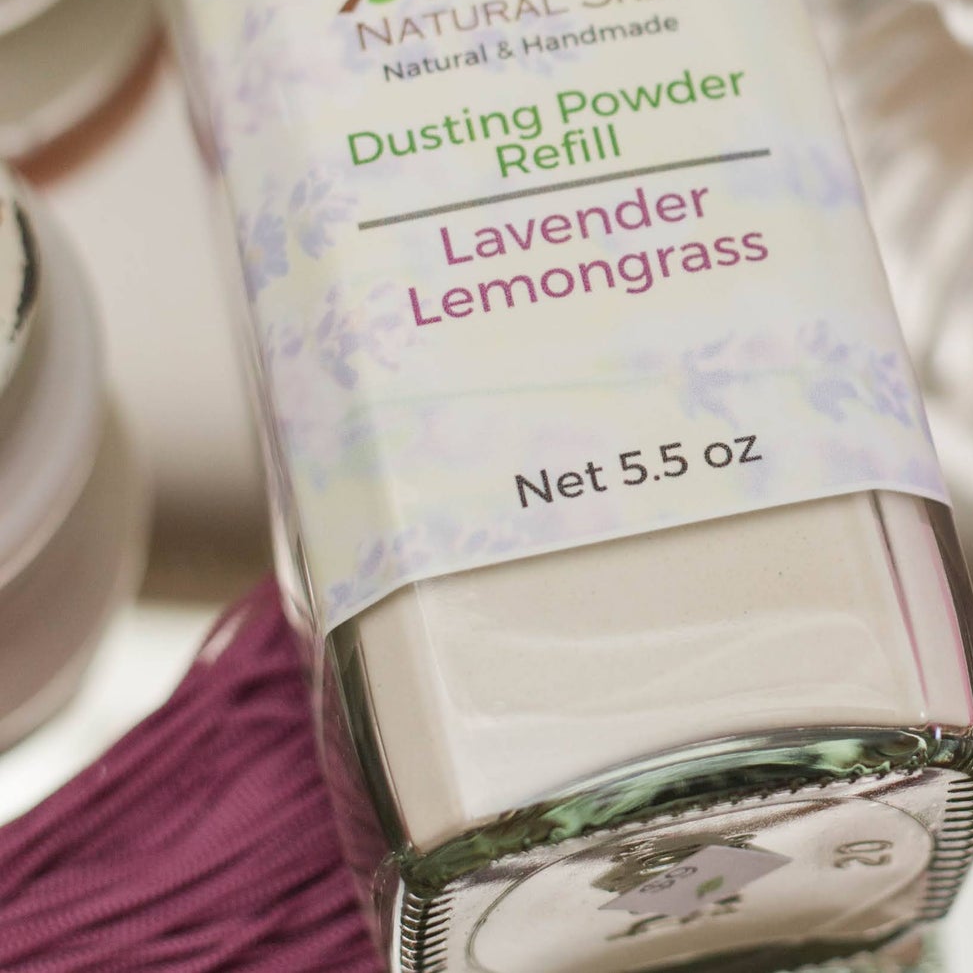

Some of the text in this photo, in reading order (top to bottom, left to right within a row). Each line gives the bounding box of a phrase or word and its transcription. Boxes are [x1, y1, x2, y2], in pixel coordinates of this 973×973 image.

[383, 14, 680, 83] Natural & Handmade
[347, 69, 746, 167] Dusting Powder
[495, 124, 622, 178] Refill
[440, 187, 709, 266] Lavender
[408, 231, 770, 327] Lemongrass
[514, 434, 763, 509] Net 5.5 oz
